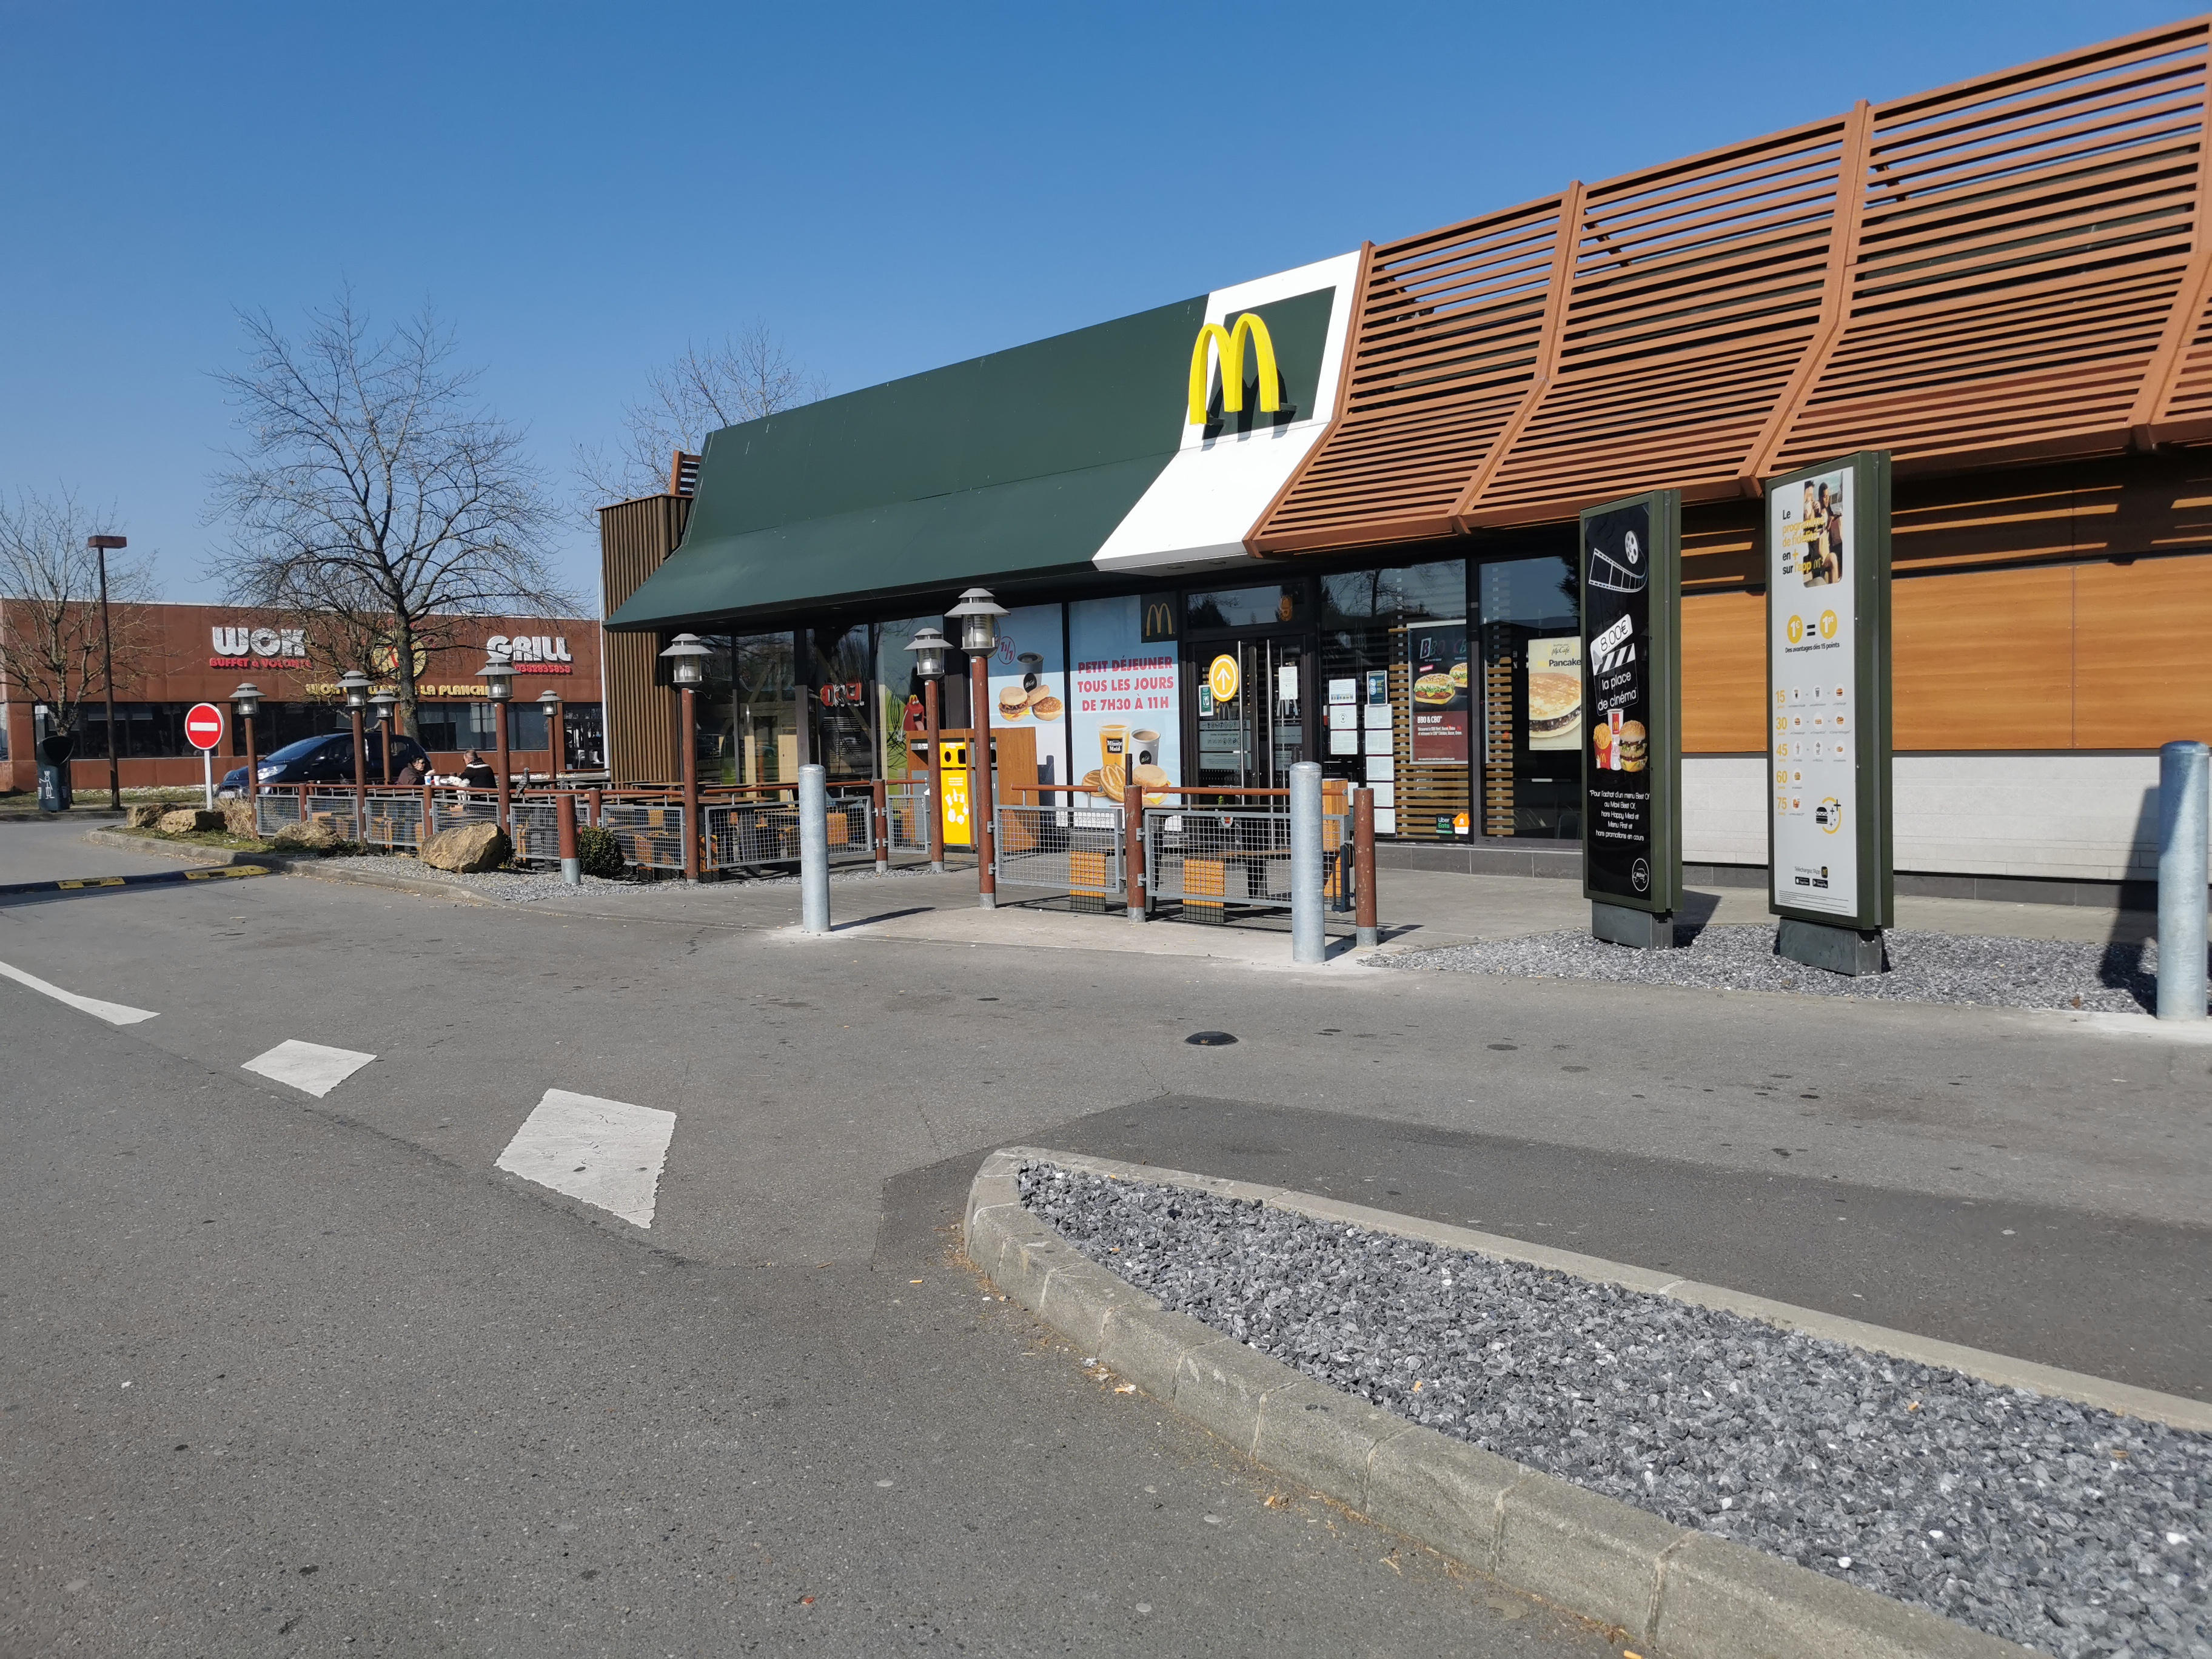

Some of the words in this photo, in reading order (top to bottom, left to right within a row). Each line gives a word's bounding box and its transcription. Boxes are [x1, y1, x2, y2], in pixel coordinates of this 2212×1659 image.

[1783, 509, 1791, 520] Le
[1782, 517, 1825, 537] programme
[1782, 537, 1791, 547] de
[1783, 552, 1791, 561] en
[1783, 565, 1794, 575] sur
[212, 626, 305, 656] WOK
[1600, 620, 1628, 651] 8.00€
[487, 635, 571, 662] GRILL
[209, 658, 249, 668] BUFFET
[1078, 660, 1108, 674] PETIT
[1111, 655, 1173, 672] DÉJEUNER
[1078, 680, 1107, 693] TOUS
[1111, 679, 1130, 691] LES
[1134, 676, 1174, 691] JOURS
[1602, 679, 1609, 691] la
[1610, 671, 1631, 690] place
[420, 685, 436, 695] LA
[1775, 689, 1785, 703] 15
[1082, 699, 1096, 711] DE
[1100, 698, 1131, 711] 7H30
[1134, 693, 1143, 709] À
[1147, 696, 1169, 709] 11H
[1598, 699, 1608, 711] de
[1776, 717, 1788, 730] 30
[1776, 743, 1788, 756] 45
[1776, 770, 1788, 783] 60
[1777, 797, 1787, 809] 75
[1611, 811, 1624, 820] Happy
